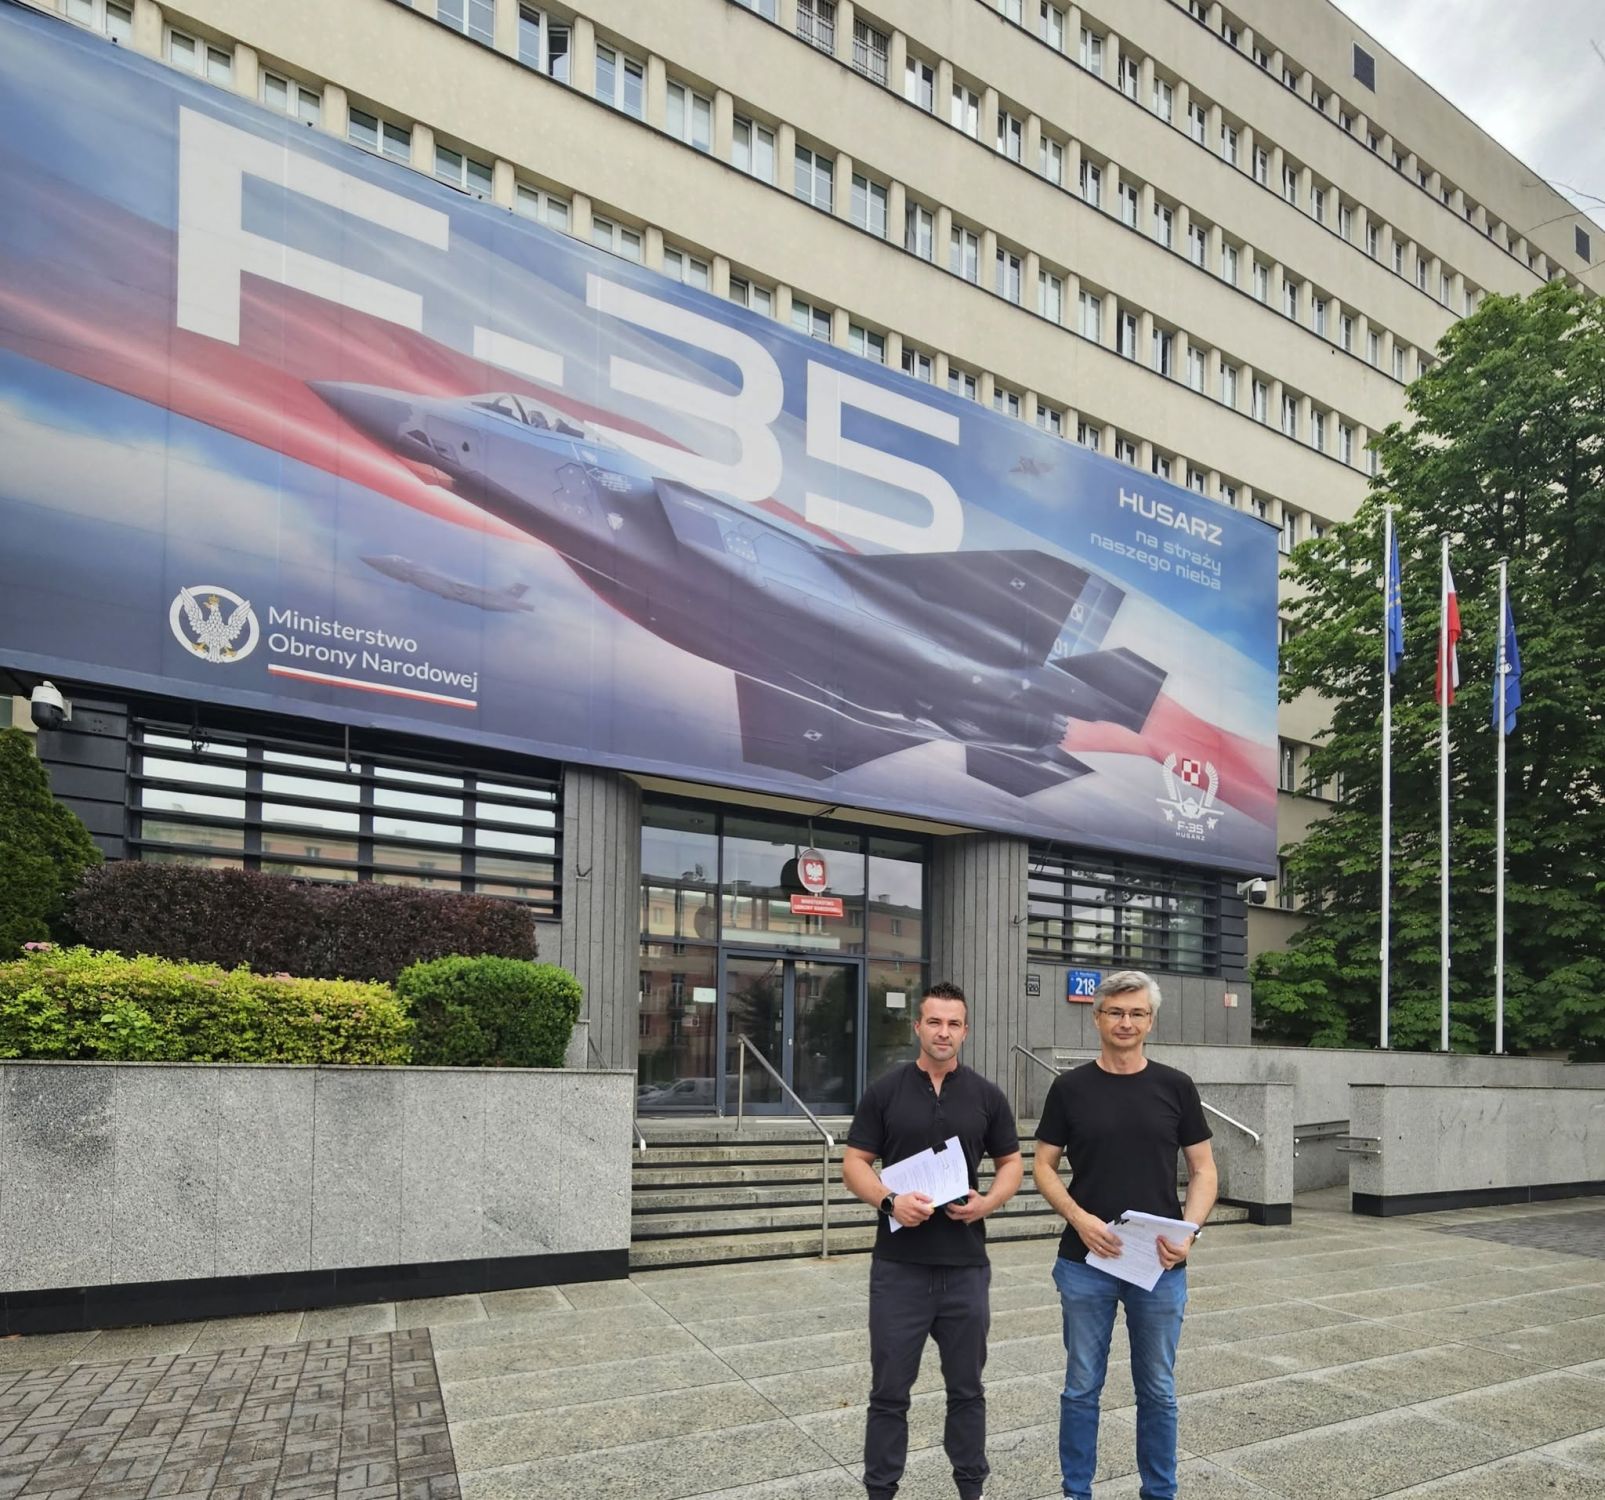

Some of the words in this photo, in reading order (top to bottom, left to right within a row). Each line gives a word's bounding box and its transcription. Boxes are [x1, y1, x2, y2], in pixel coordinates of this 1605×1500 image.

[177, 105, 964, 555] F-35
[1119, 487, 1223, 546] HUSARZ
[1090, 532, 1171, 571] naszego
[1175, 564, 1221, 590] nieba
[1135, 530, 1158, 548] na
[1163, 543, 1222, 576] straży
[268, 605, 418, 653] Ministerstwo
[268, 633, 358, 670] Obrony
[361, 650, 479, 693] Narodowej
[1075, 977, 1096, 996] 218
